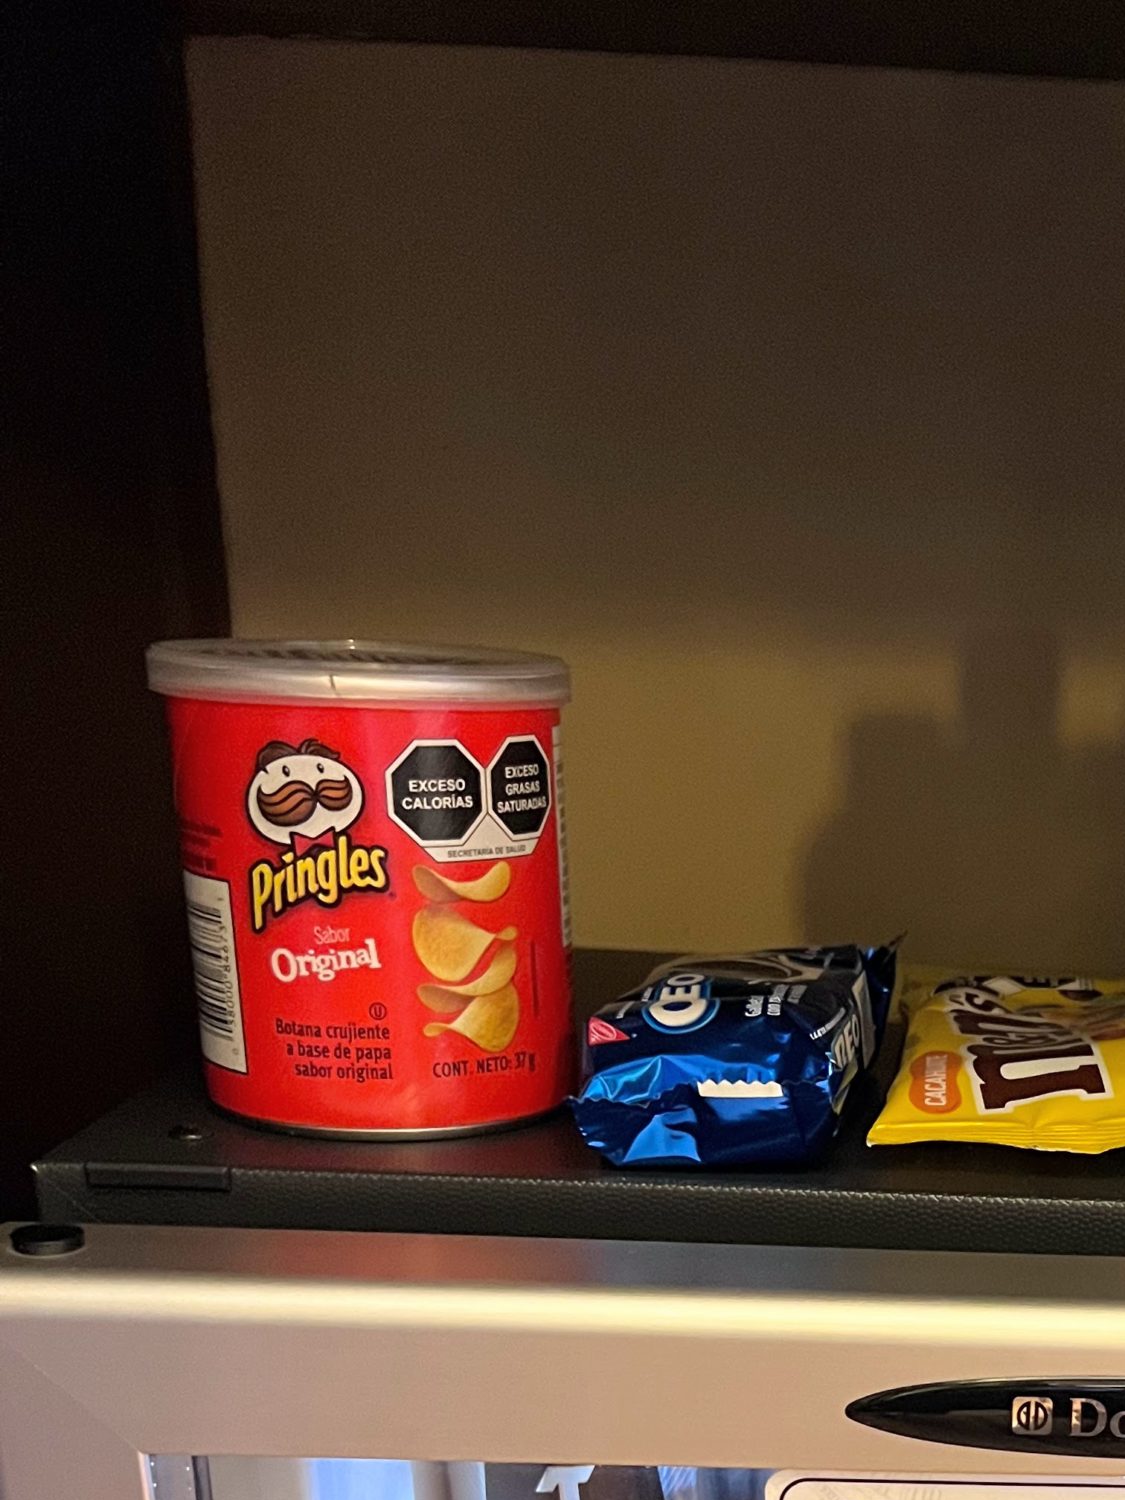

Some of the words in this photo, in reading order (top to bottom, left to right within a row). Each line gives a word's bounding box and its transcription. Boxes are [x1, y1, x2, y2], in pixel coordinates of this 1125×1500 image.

[505, 764, 539, 778] EXCESO
[408, 779, 466, 792] EXCESO
[505, 781, 540, 796] GRASAS
[401, 794, 473, 810] CALORÍAS
[497, 796, 547, 814] SATURADAS
[252, 835, 386, 931] Pringles
[313, 926, 350, 945] Sabor
[271, 937, 382, 983] Original
[275, 1018, 322, 1039] Botana
[325, 1022, 390, 1044] crujiente
[286, 1043, 294, 1056] a
[297, 1040, 330, 1059] base
[334, 1043, 351, 1060] de
[355, 1046, 391, 1063] papa
[294, 1061, 332, 1078] sabor
[336, 1062, 394, 1083] original
